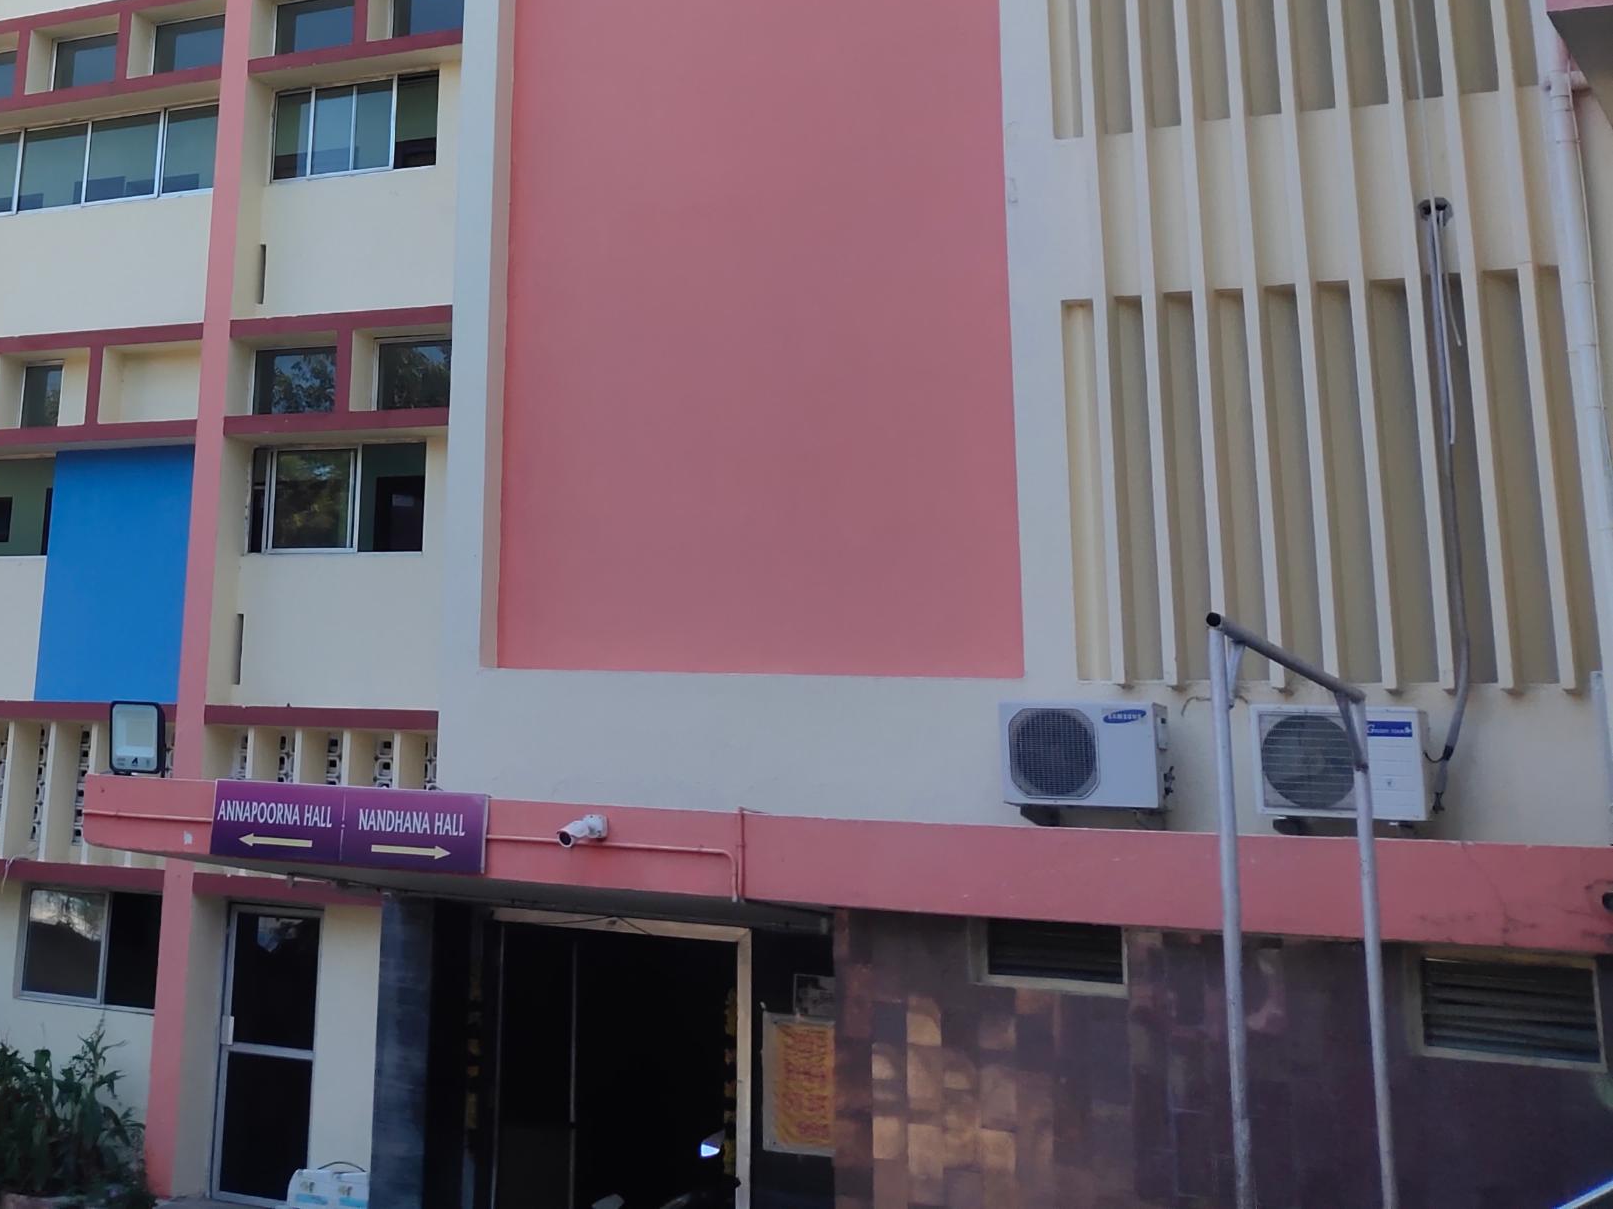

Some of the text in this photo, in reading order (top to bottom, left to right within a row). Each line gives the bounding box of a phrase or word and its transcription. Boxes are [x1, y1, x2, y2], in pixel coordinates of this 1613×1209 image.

[217, 799, 333, 828] ANNAPOORNA HALL
[358, 808, 466, 837] NANDHANA HALL
